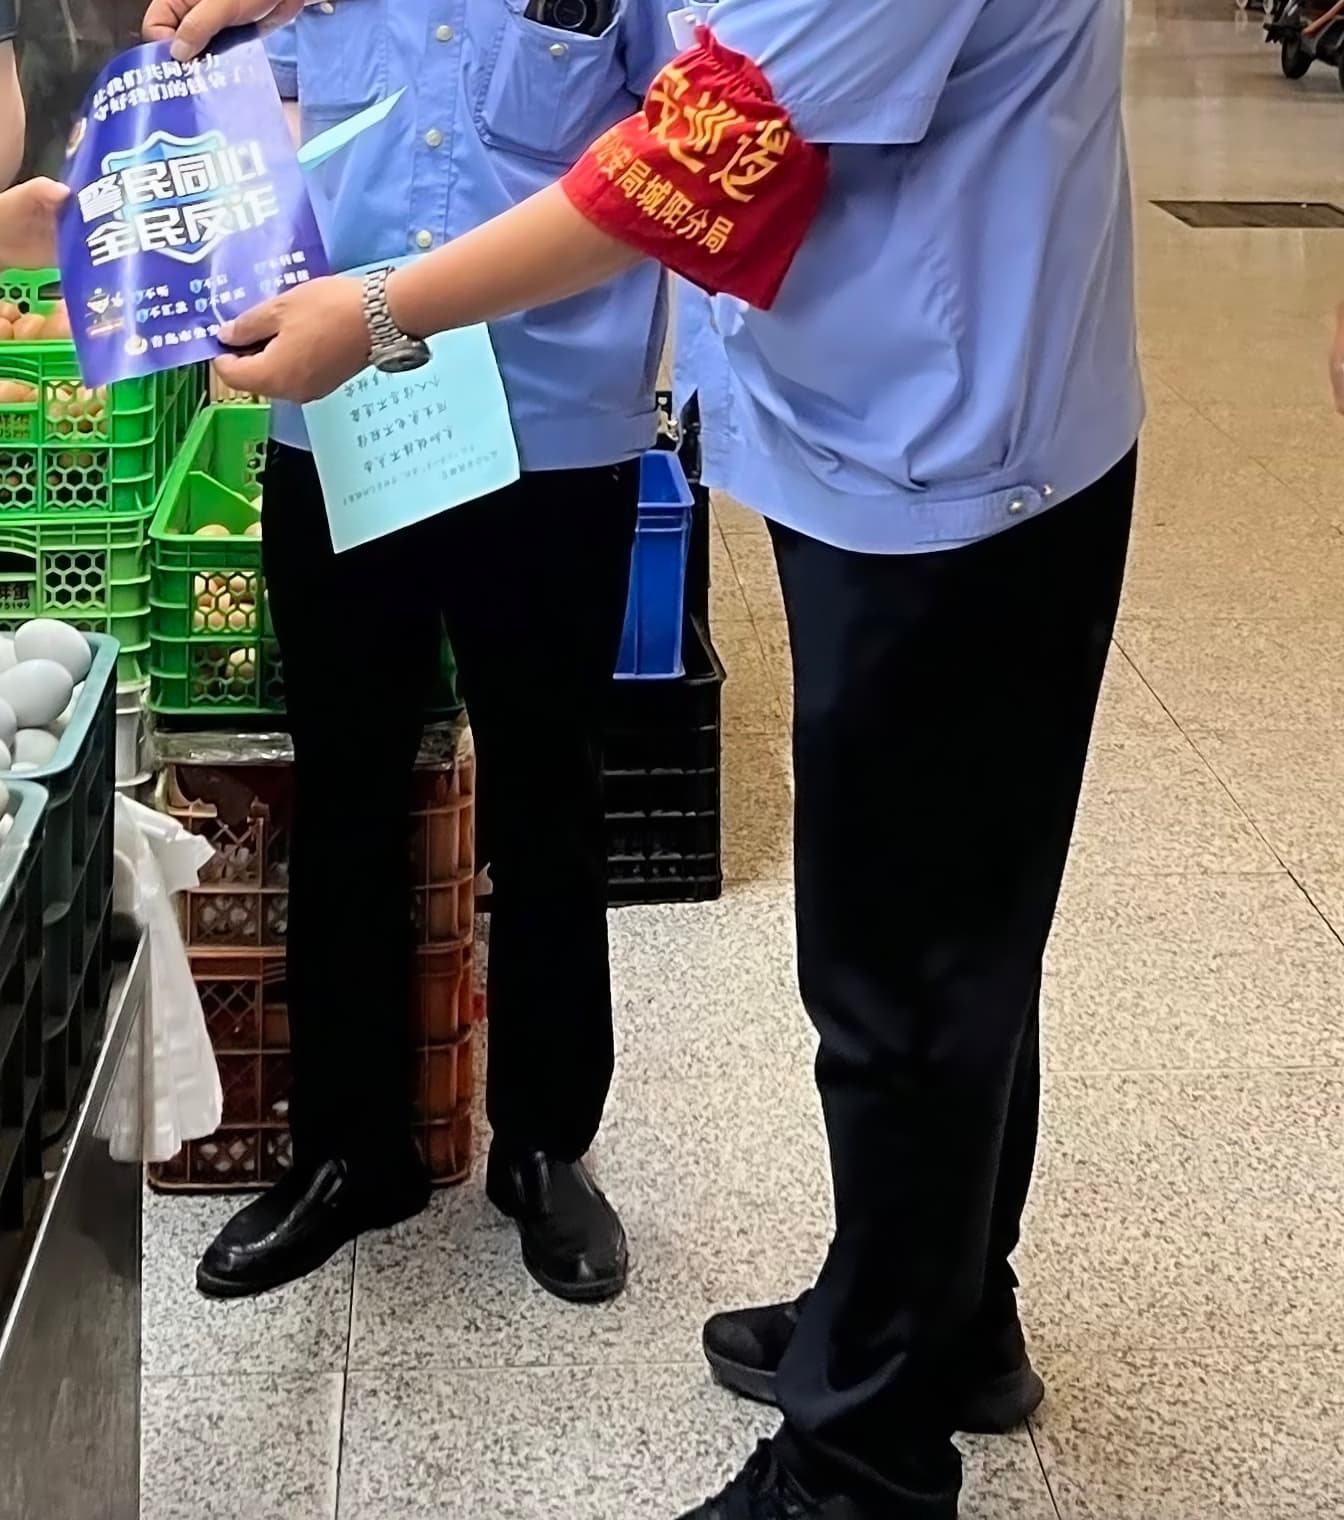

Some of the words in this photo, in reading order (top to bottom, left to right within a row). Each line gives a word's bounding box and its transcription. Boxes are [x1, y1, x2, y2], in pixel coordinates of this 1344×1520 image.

[77, 141, 268, 223] 警民同心
[86, 183, 281, 266] 全民反诈
